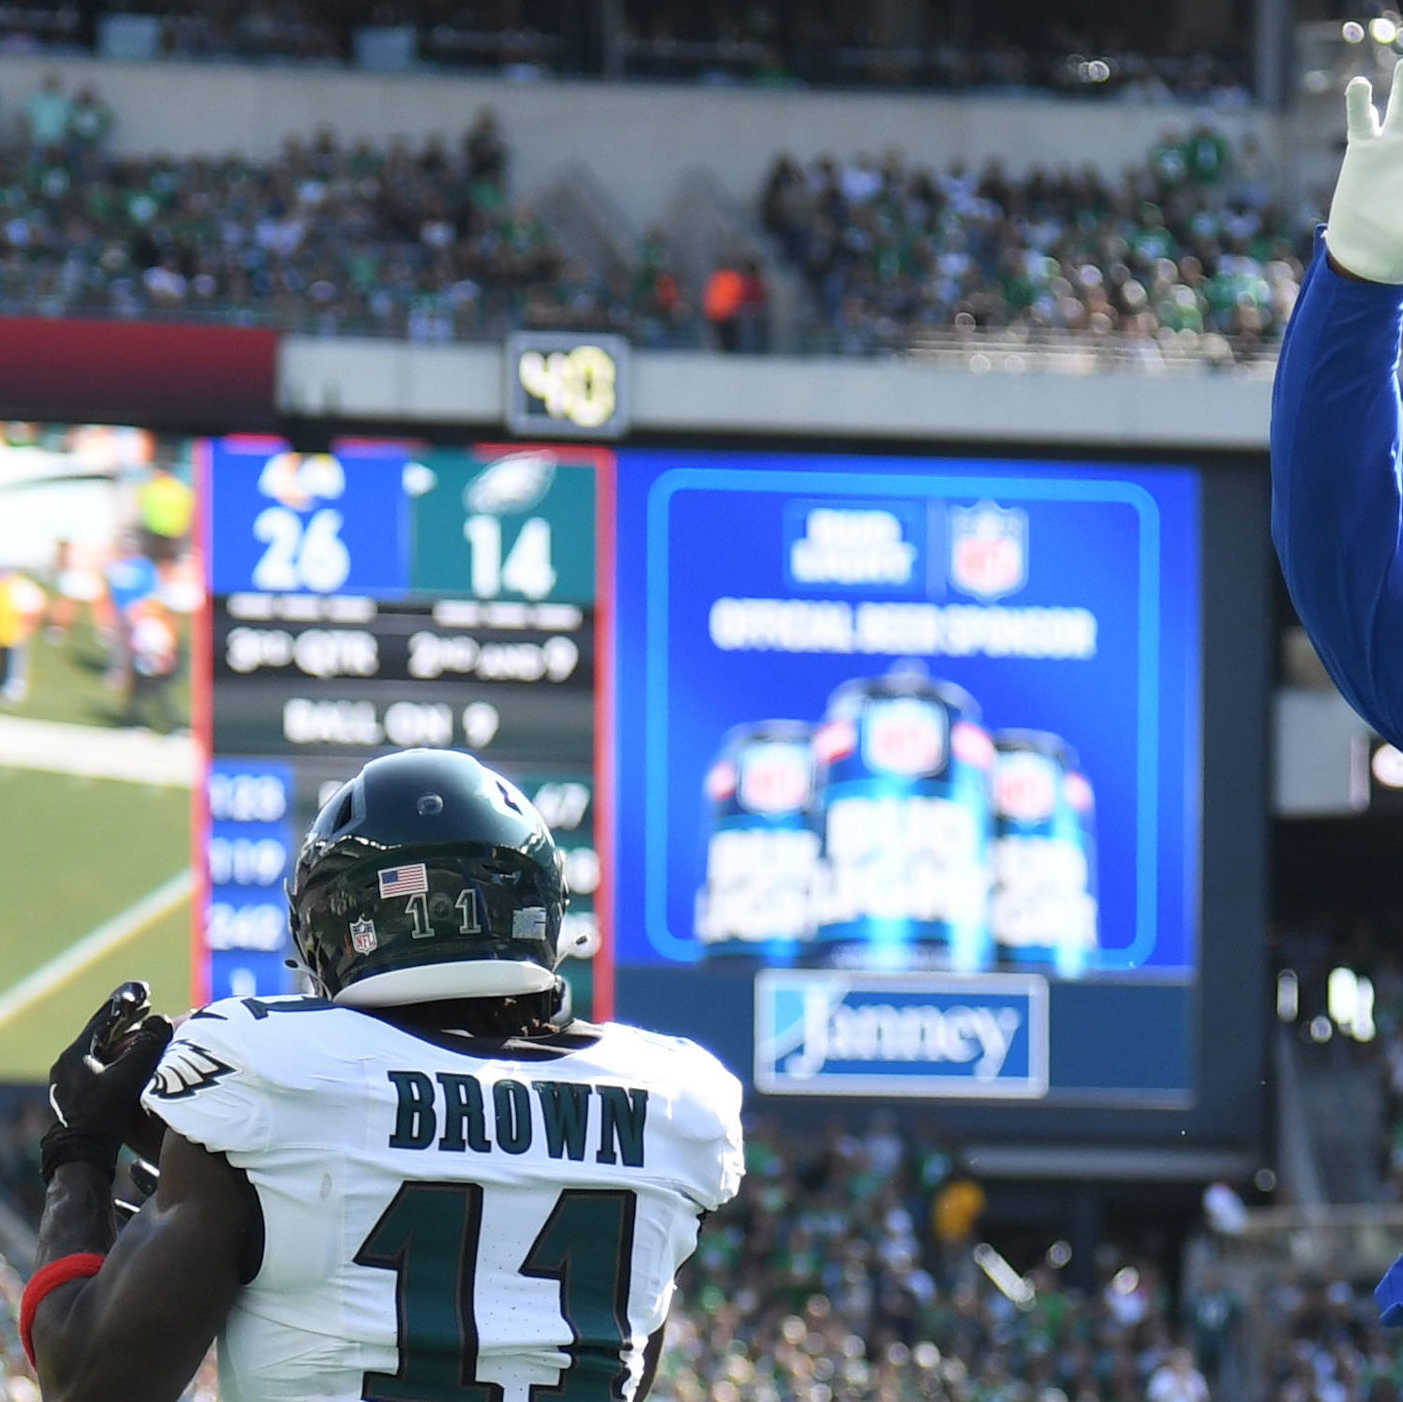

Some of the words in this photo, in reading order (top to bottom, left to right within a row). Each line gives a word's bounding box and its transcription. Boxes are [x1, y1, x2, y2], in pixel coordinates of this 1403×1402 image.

[253, 506, 350, 592] 26
[463, 515, 556, 598] 14
[404, 888, 482, 939] 11
[784, 980, 1021, 1083] Janney
[387, 1070, 648, 1168] BROWN
